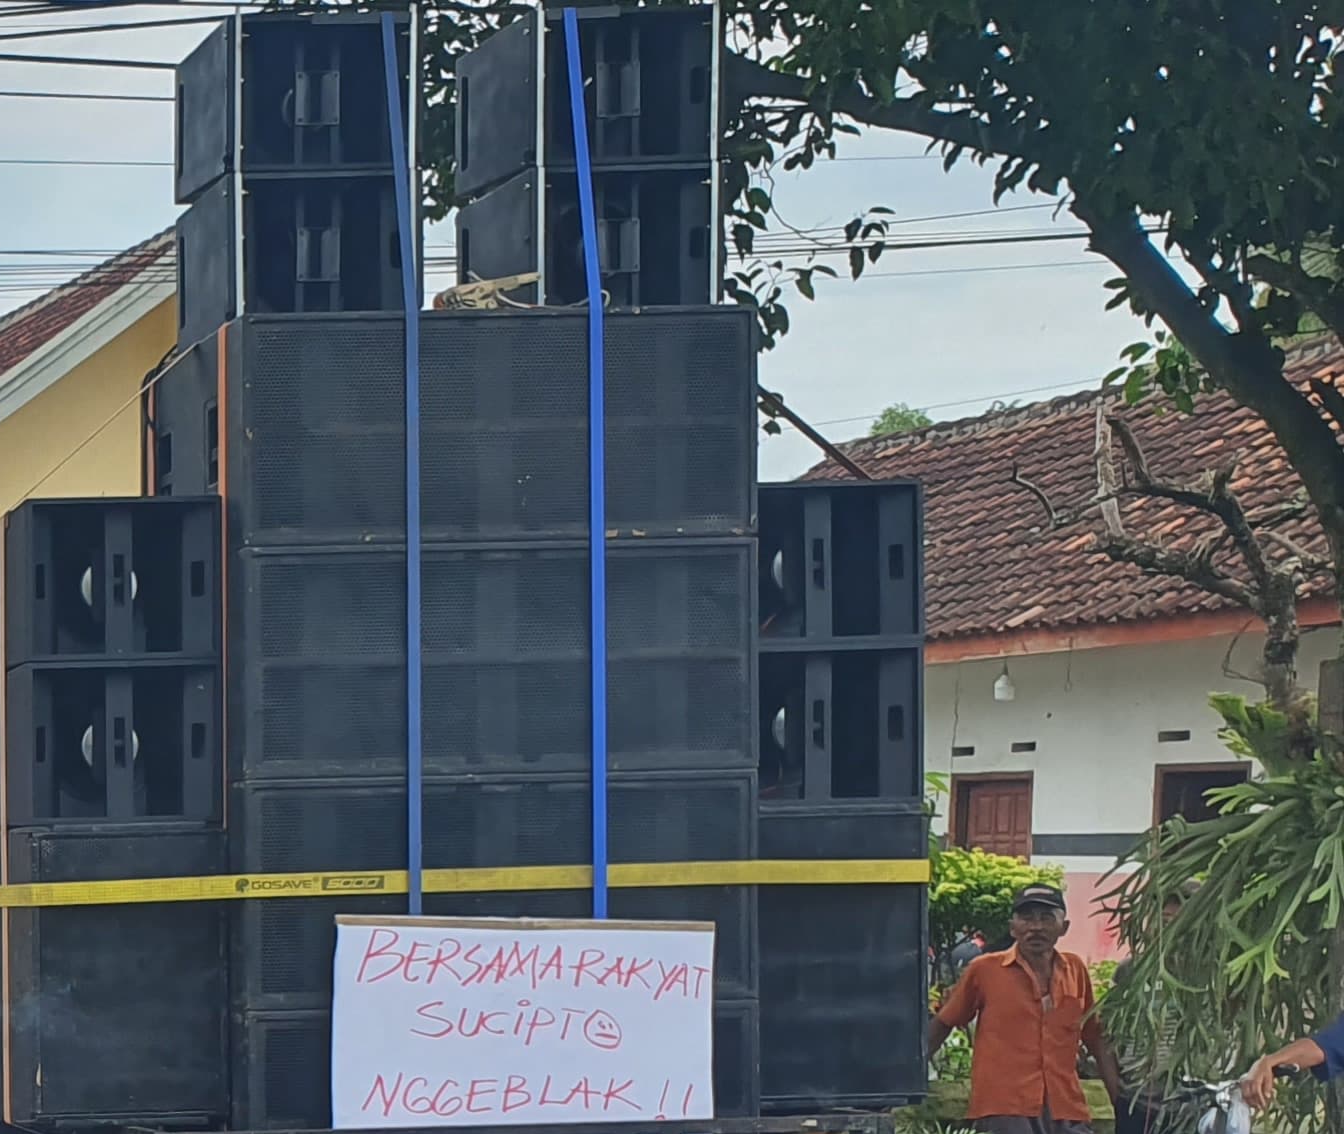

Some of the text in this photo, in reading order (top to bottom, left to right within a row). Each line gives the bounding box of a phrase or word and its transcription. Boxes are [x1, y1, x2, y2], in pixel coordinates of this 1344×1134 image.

[250, 879, 312, 890] GOSAVE
[356, 928, 711, 1000] BERSAMA RAKYAT
